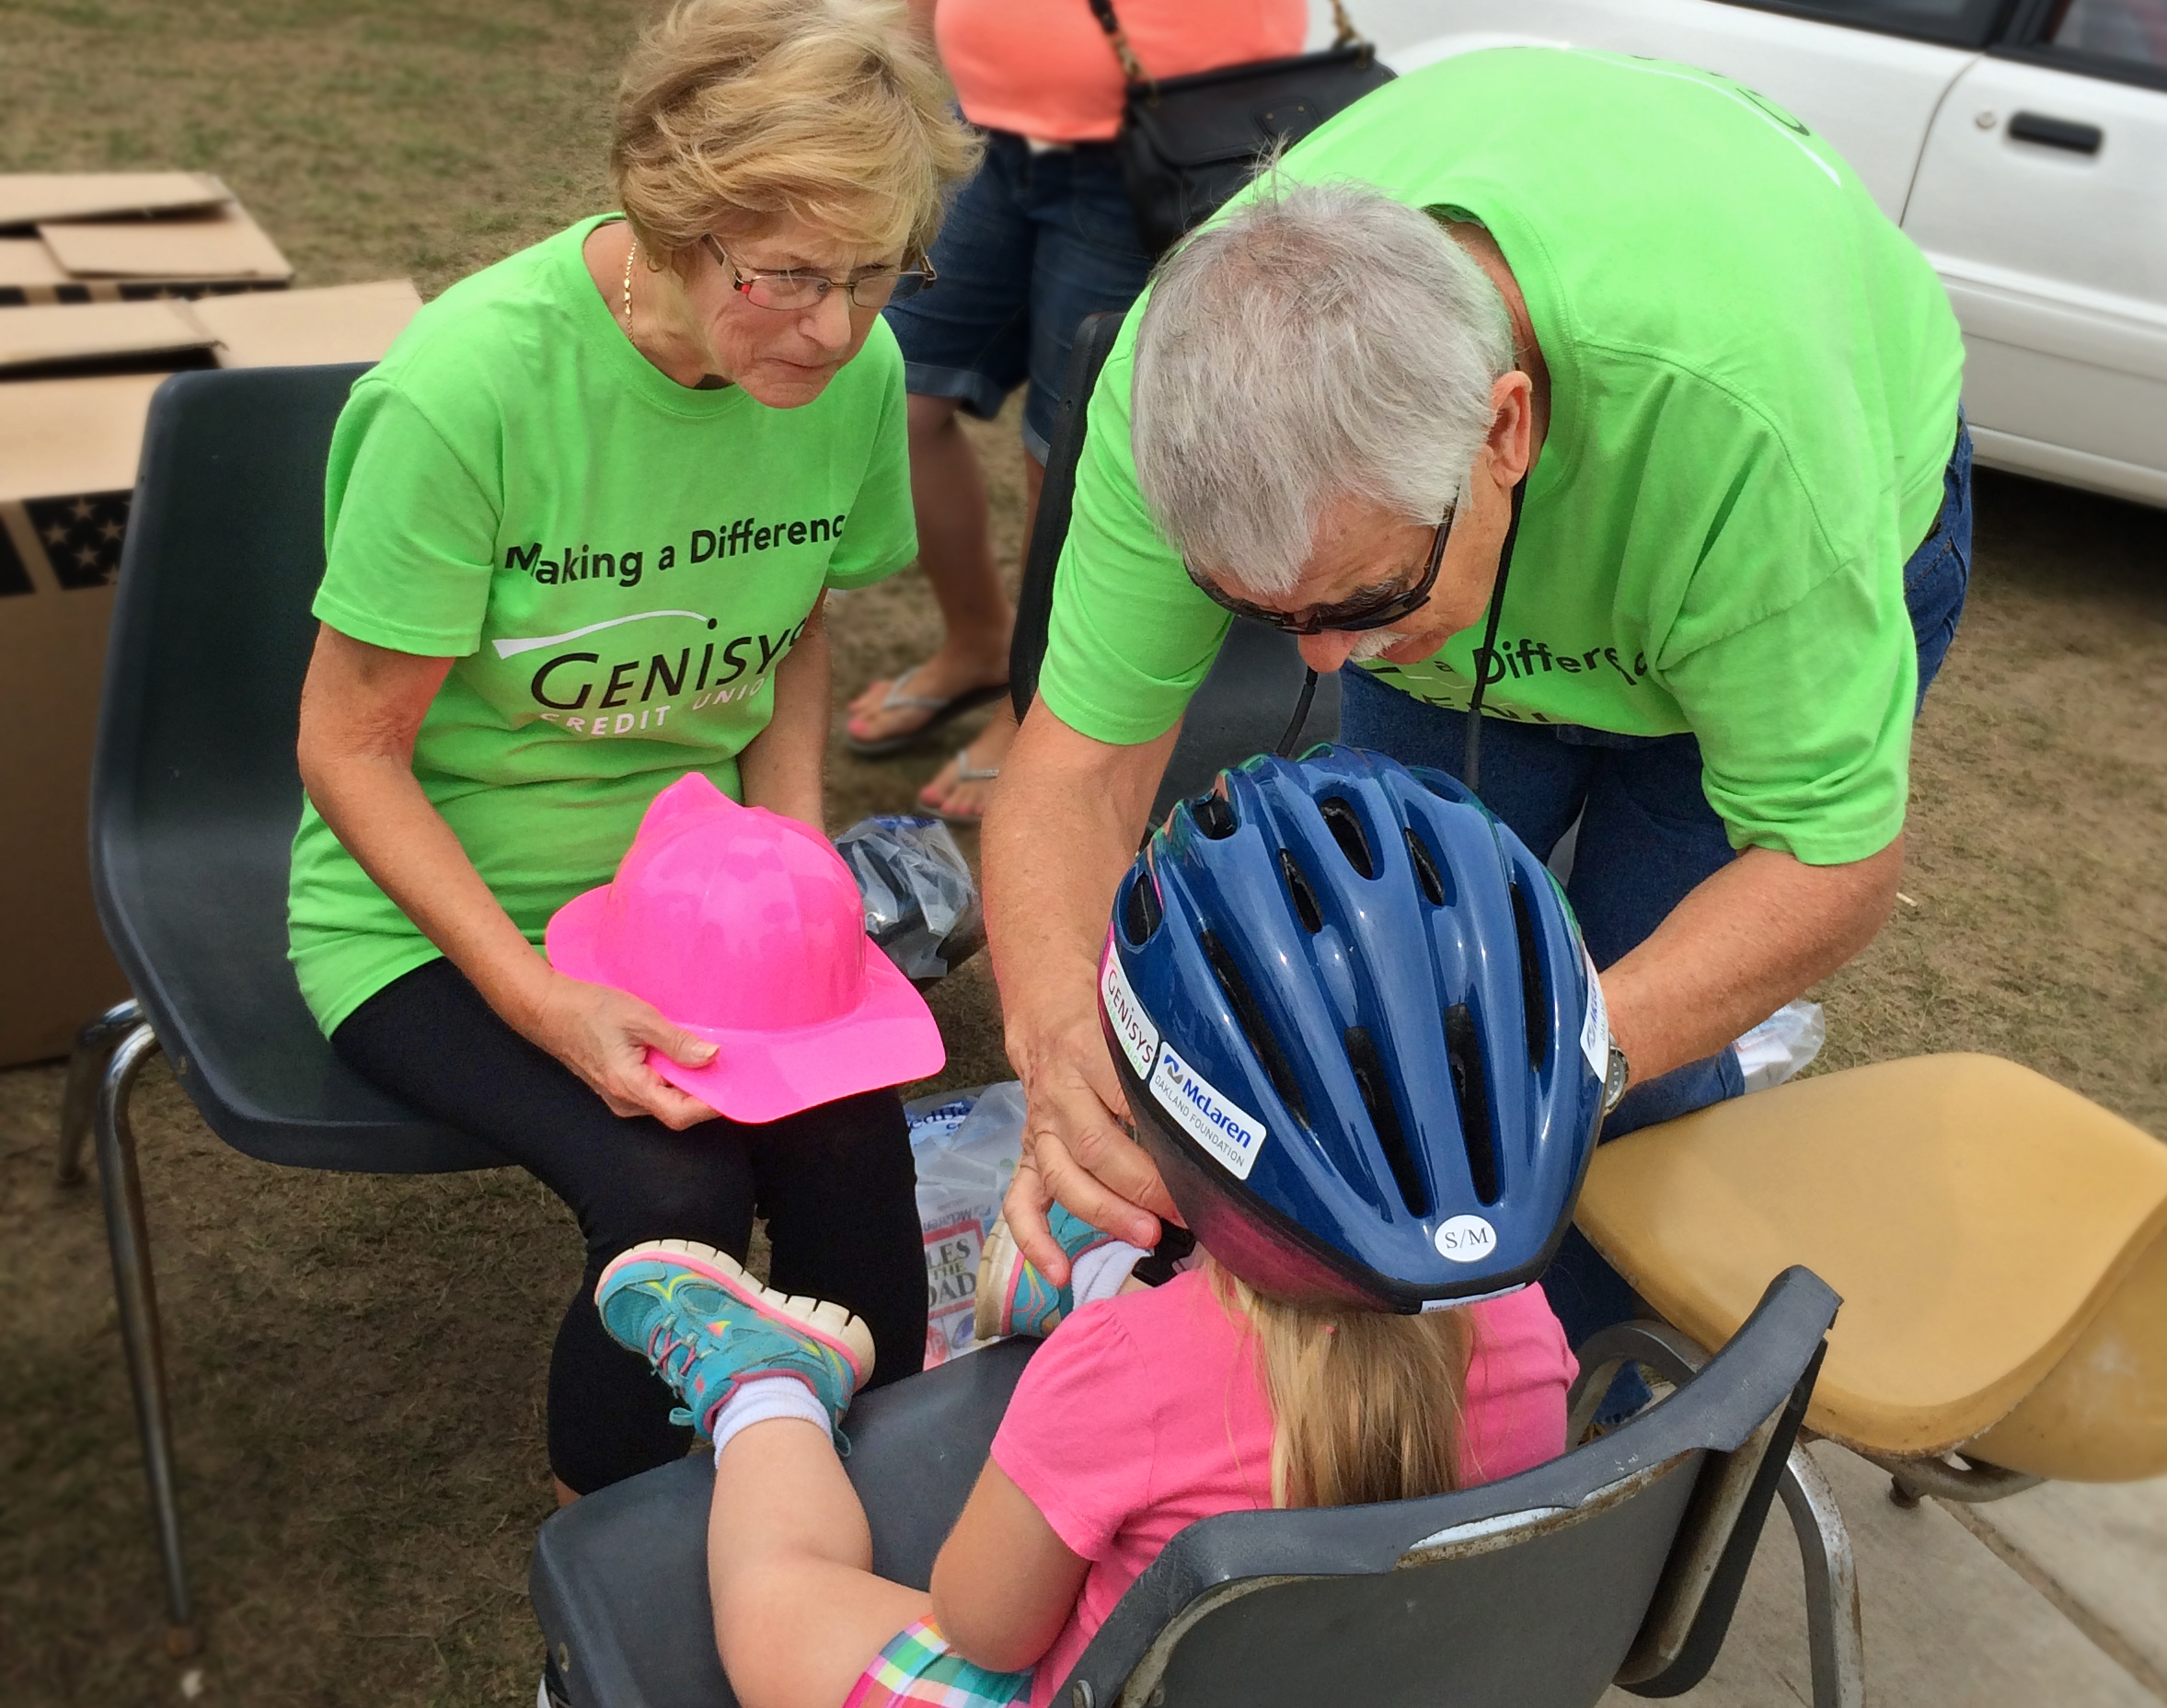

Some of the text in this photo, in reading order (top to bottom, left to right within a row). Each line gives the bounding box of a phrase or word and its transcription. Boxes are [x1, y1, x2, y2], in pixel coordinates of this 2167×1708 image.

[502, 514, 847, 587] Making a Differenc
[692, 677, 766, 710] UNIO
[1122, 1035, 1144, 1073] UNION
[1154, 1074, 1246, 1168] OAKLAND FOUNDATION
[1181, 1078, 1252, 1148] McLaren
[925, 1237, 971, 1270] LES
[1444, 1227, 1489, 1249] S/M
[928, 1271, 976, 1308] OAD
